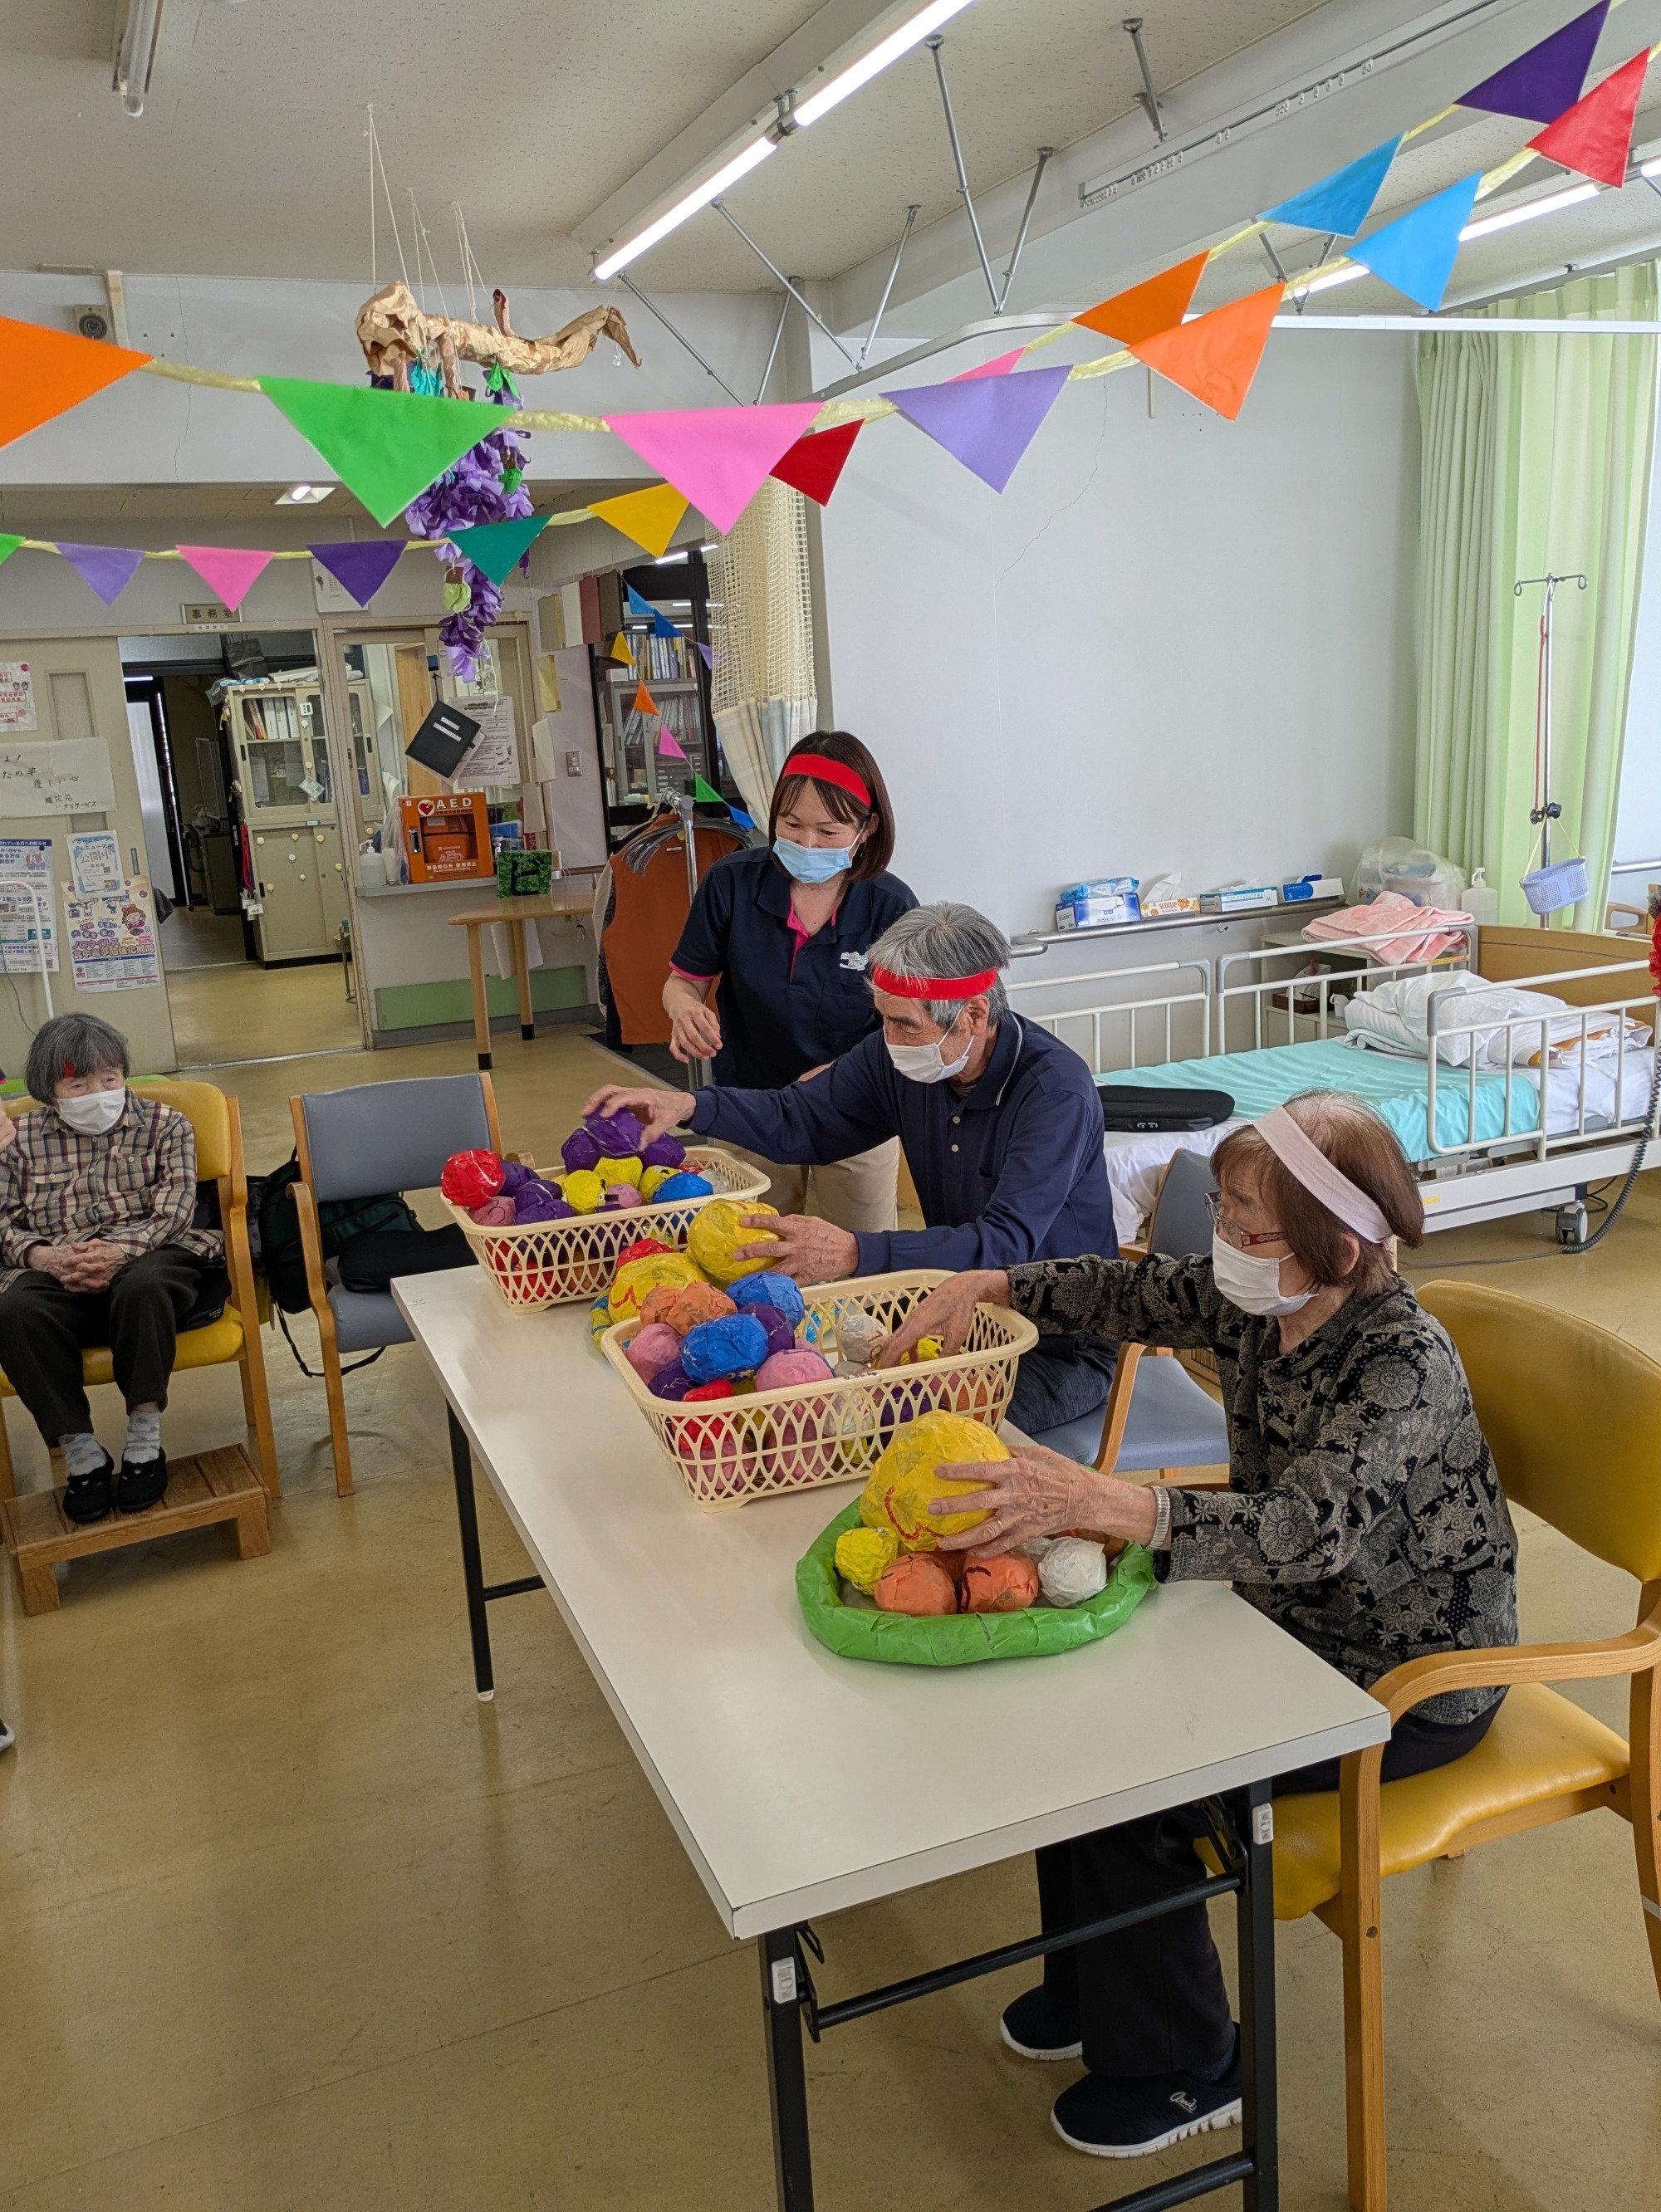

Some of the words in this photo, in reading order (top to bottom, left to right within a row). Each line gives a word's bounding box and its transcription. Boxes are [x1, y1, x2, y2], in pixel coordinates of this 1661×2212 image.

[192, 609, 233, 619] 事務室
[436, 797, 472, 809] AED
[71, 937, 120, 950] ノロウイルス
